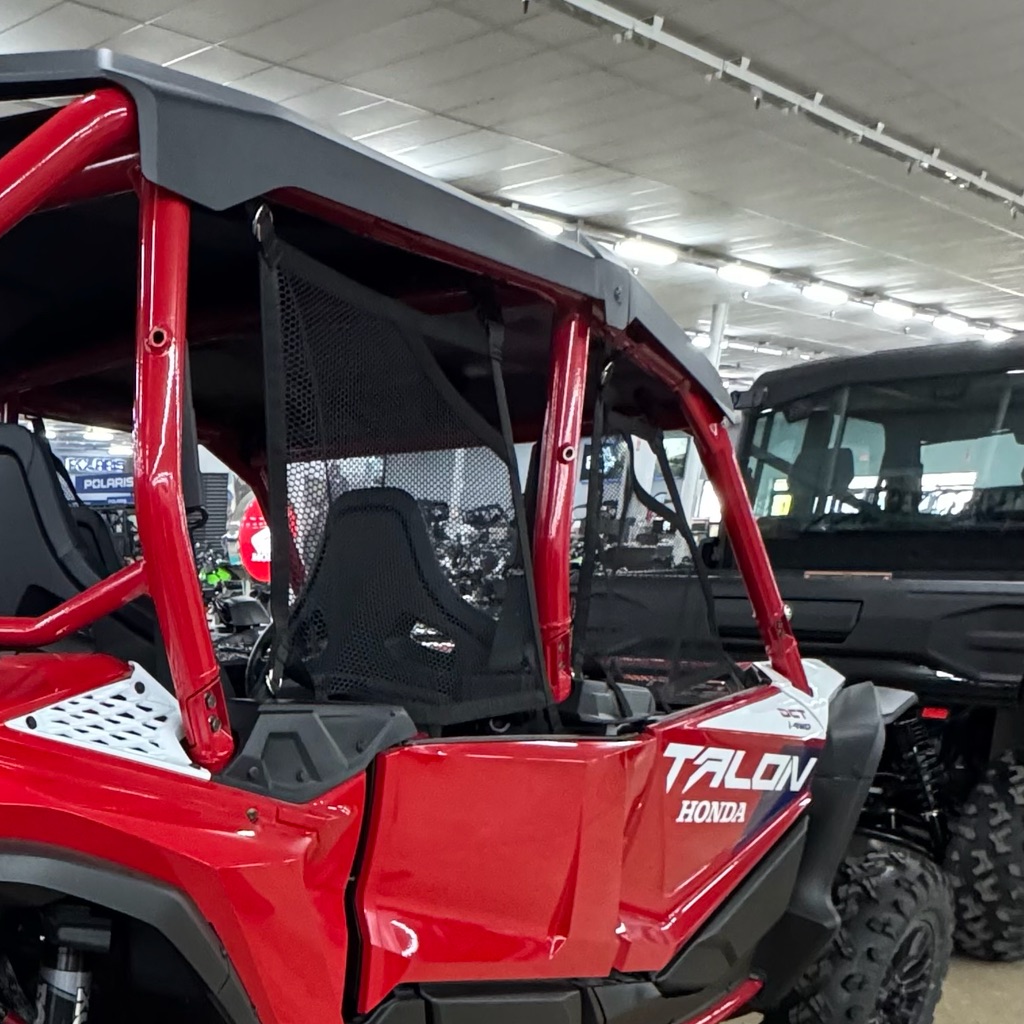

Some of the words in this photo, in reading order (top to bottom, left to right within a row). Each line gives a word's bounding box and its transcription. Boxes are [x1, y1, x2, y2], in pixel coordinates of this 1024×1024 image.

[84, 477, 134, 490] POLARIS
[663, 742, 818, 794] TALON
[676, 800, 747, 823] HONDA
